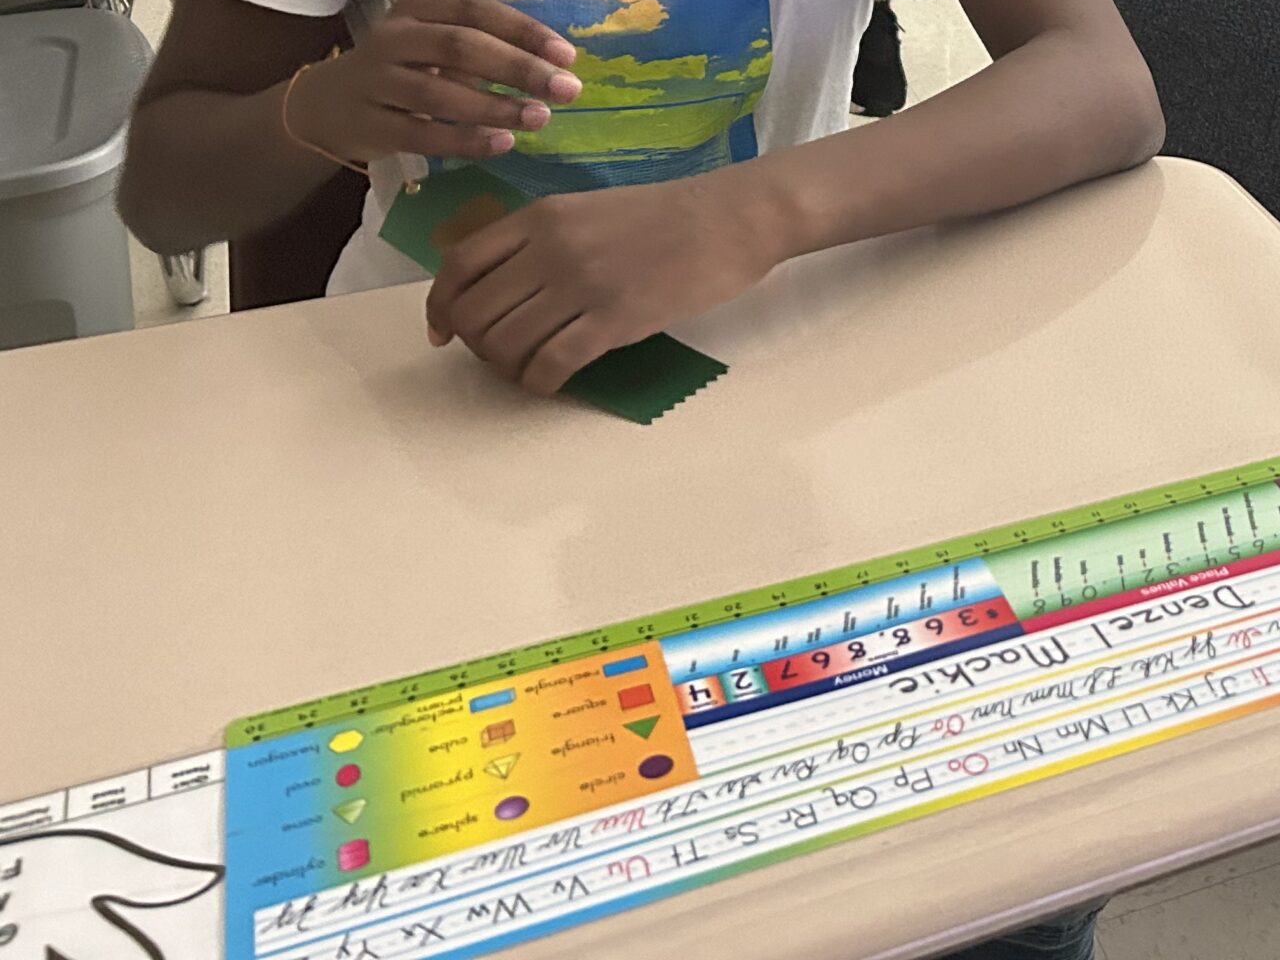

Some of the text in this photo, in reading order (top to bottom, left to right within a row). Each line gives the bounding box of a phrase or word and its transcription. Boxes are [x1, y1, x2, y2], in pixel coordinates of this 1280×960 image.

[856, 570, 868, 579] 17
[1141, 567, 1228, 594] Place Values
[724, 602, 741, 611] 20
[771, 592, 785, 600] 19
[637, 624, 653, 633] 22
[685, 613, 697, 621] 21
[925, 618, 943, 634] 6
[958, 608, 977, 626] 3
[591, 635, 608, 645] 23
[890, 585, 1253, 692] Denzel Mackie
[1185, 631, 1215, 658] Jj
[544, 647, 562, 656] 24
[811, 651, 829, 668] 6
[847, 641, 865, 660] 8
[449, 671, 466, 680] 26
[497, 659, 515, 669] 25
[781, 660, 796, 679] 7
[831, 662, 889, 687] Money
[1131, 652, 1178, 678] Kk
[525, 670, 599, 693] rectangle
[1083, 666, 1121, 694] Ll
[1199, 665, 1235, 699] Jj
[1251, 666, 1272, 686] Ii
[400, 683, 417, 694] 27
[689, 685, 711, 701] 4
[1022, 681, 1077, 703] Mm
[350, 696, 366, 706] 28
[416, 689, 462, 712] prism
[553, 699, 606, 717] square
[971, 701, 1015, 719] Nn
[1161, 689, 1197, 712] Kk
[298, 709, 316, 720] 29
[373, 703, 463, 735] rectangular
[931, 714, 964, 738] Oo
[1121, 702, 1151, 727] Ll
[244, 723, 264, 734] 30
[878, 722, 919, 750] Pp
[1056, 715, 1109, 740] Mm
[248, 744, 320, 766] hexagon
[428, 737, 467, 752] cube
[551, 733, 614, 755] triangle
[828, 739, 869, 763] Qq
[1003, 735, 1043, 759] Nn
[772, 757, 817, 781] Rr
[947, 752, 988, 776] Oo
[285, 776, 322, 796] oval
[399, 769, 472, 802] pyramid
[579, 772, 624, 791] circle
[716, 772, 760, 799] Ss
[894, 766, 933, 793] Pp
[656, 790, 707, 822] Tt
[822, 786, 876, 809] Qq
[282, 812, 324, 831] cone
[418, 814, 477, 837] sphere
[591, 807, 646, 833] Uu
[780, 803, 817, 829] Rr
[539, 826, 581, 853] Vv
[724, 821, 758, 846] Ss
[463, 843, 525, 872] Ww
[672, 839, 707, 866] Tt
[254, 856, 326, 885] cylinder
[607, 855, 650, 882] Uu
[553, 875, 589, 900] Vv
[467, 893, 531, 922] Ww
[401, 916, 444, 946] Xx
